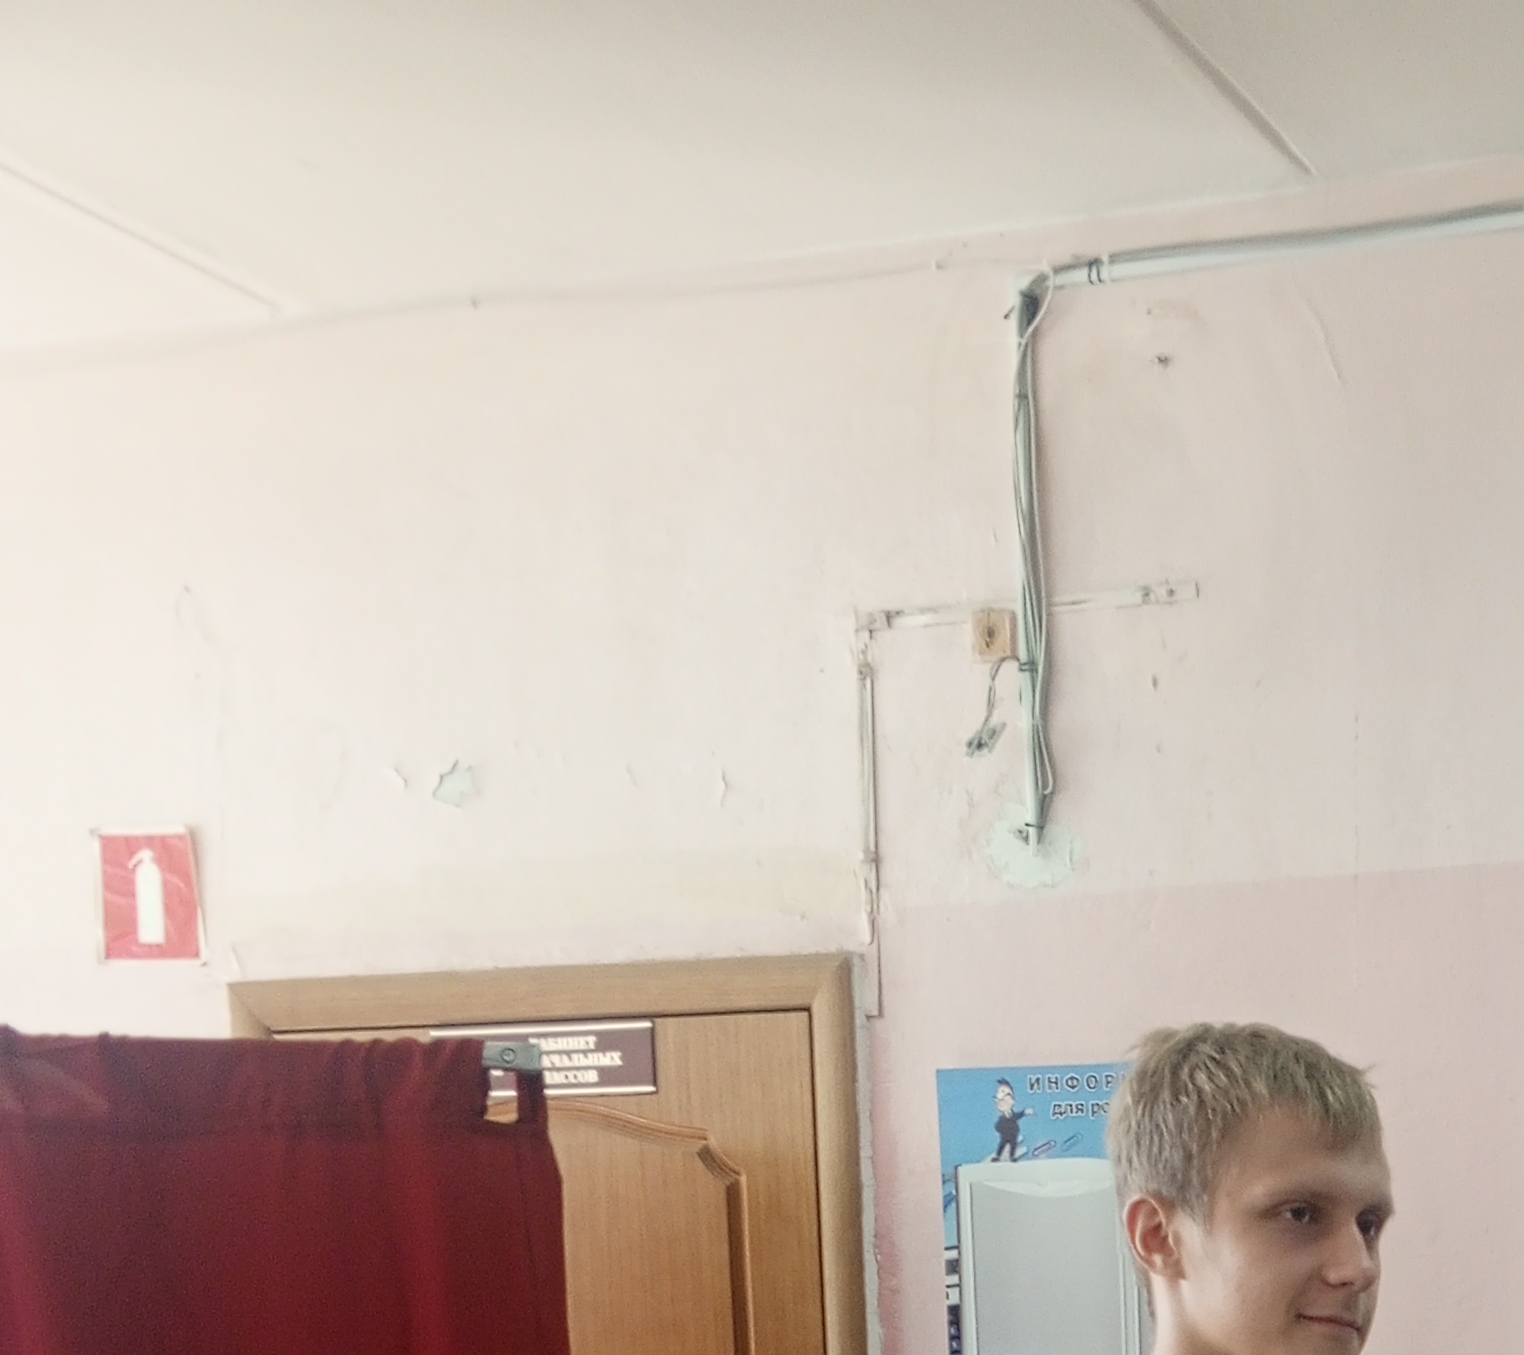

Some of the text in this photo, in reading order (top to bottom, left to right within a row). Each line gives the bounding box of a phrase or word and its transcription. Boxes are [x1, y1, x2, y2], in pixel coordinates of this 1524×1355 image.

[540, 1051, 623, 1068] АЧАЛЬНЫХ
[543, 1069, 599, 1085] ЛАССОВ
[1028, 1073, 1122, 1092] ИНФОР
[1051, 1101, 1110, 1120] для ро
